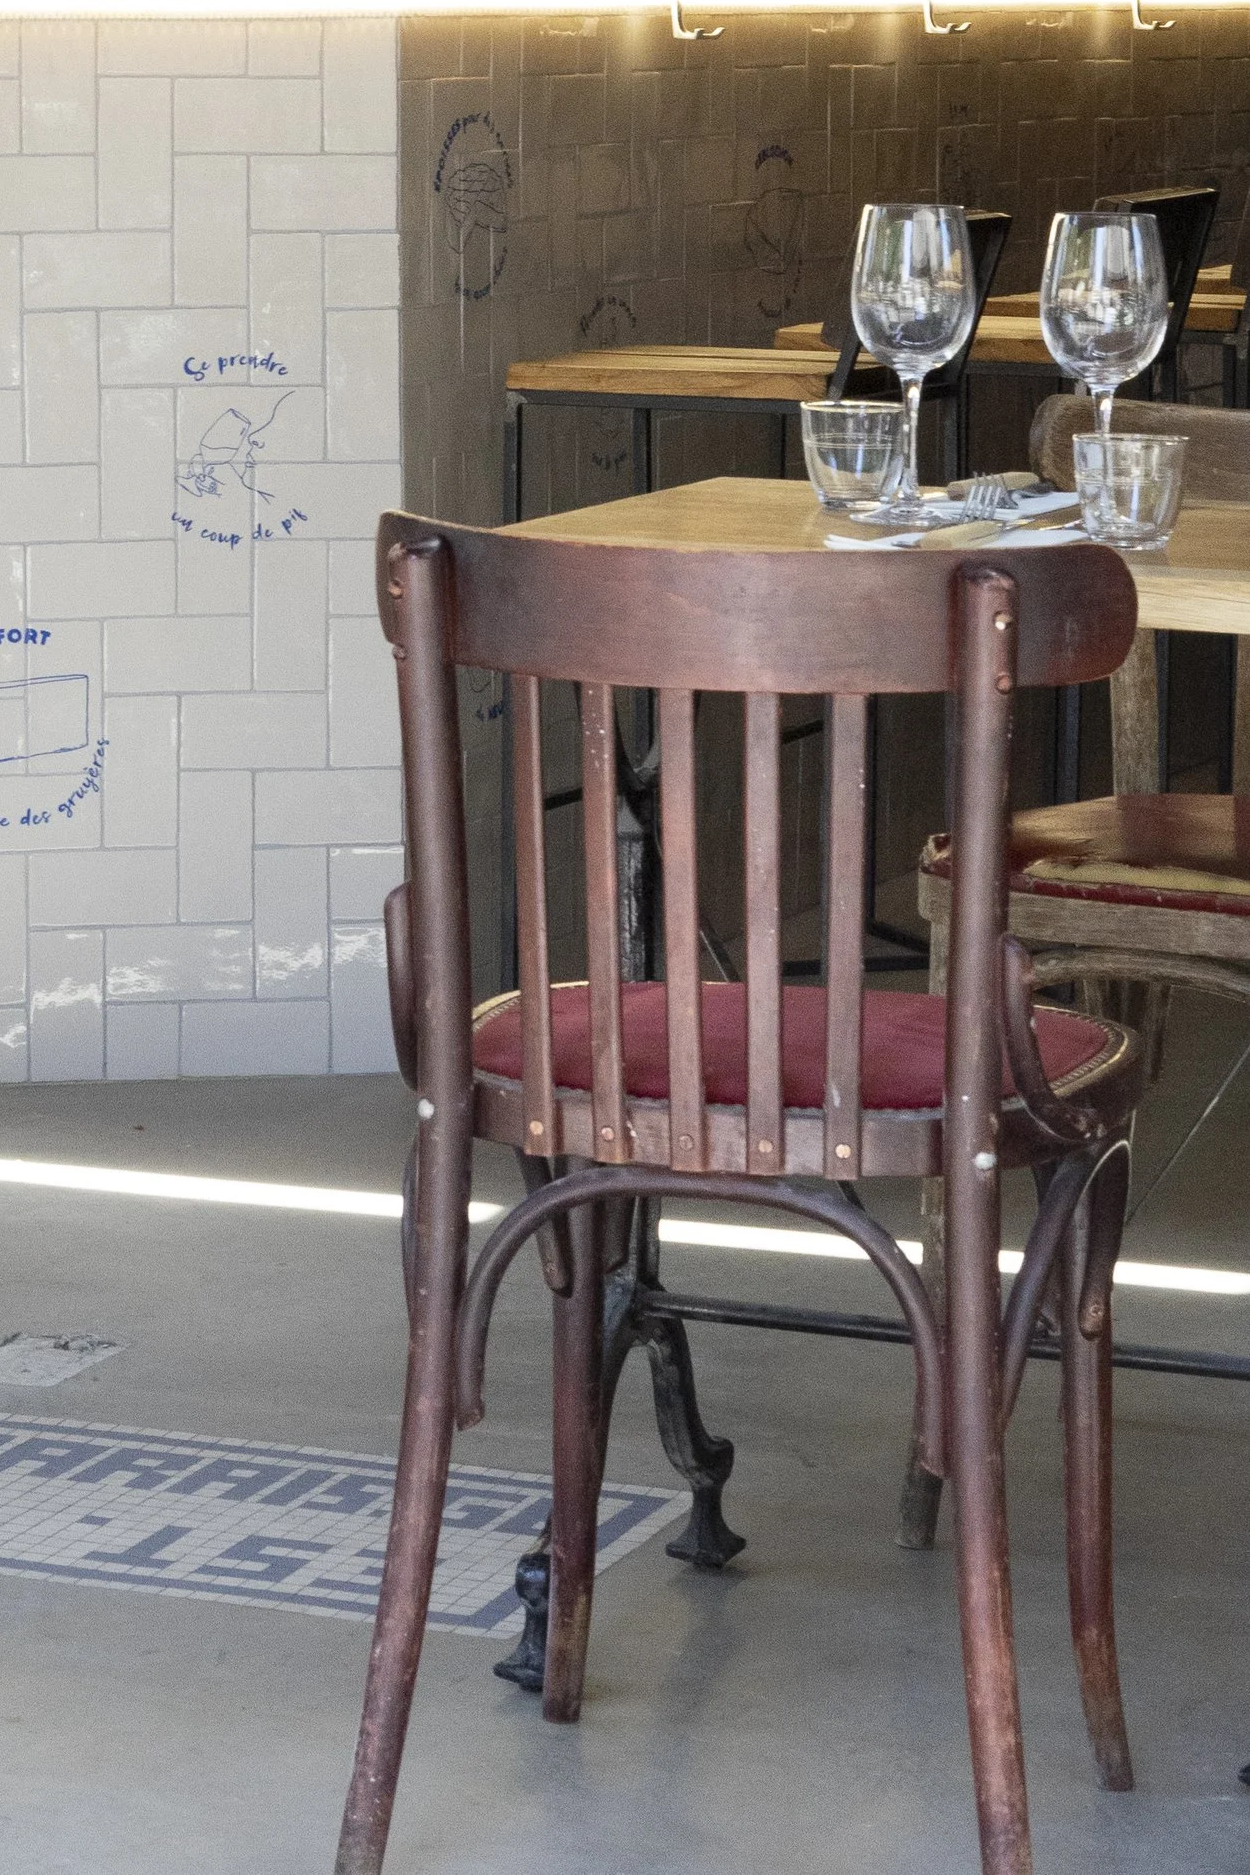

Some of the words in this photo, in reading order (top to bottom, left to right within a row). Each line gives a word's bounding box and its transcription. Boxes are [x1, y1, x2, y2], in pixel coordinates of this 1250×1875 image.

[217, 351, 289, 377] prendre
[171, 511, 194, 533] un
[201, 529, 243, 550] coup
[252, 523, 274, 541] de
[281, 508, 308, 535] pif
[20, 808, 51, 826] des
[58, 737, 110, 819] gruyères
